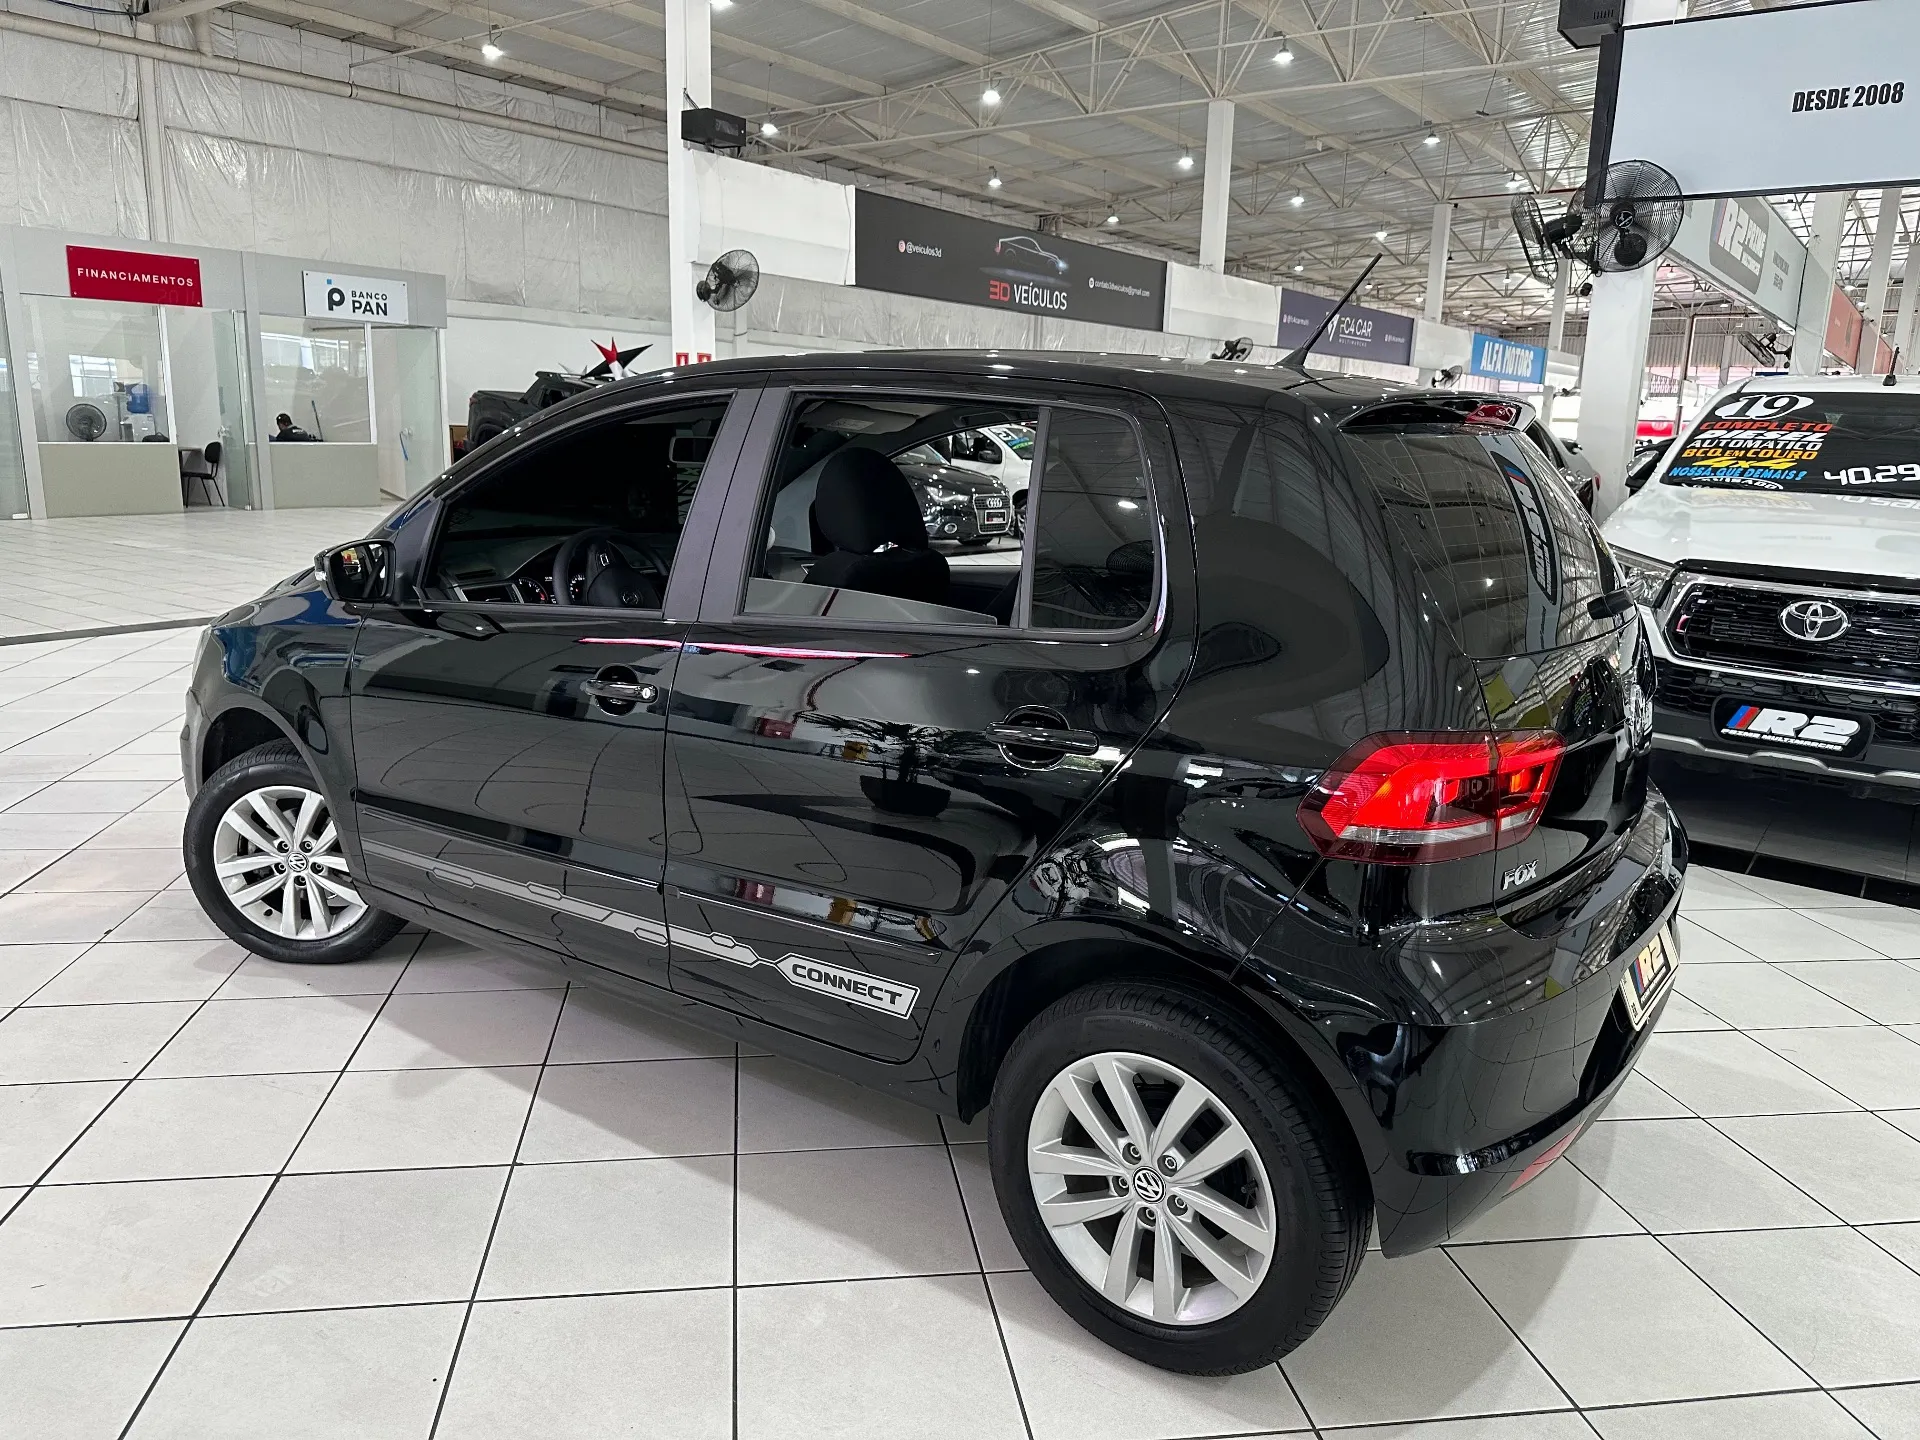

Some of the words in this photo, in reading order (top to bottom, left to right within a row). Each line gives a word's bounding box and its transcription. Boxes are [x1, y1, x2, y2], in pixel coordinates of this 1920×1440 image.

[1792, 87, 1851, 113] DESDE
[1852, 82, 1905, 108] 2008
[76, 267, 194, 287] FINANCIAMENTOS
[351, 290, 388, 301] BANCO
[989, 280, 1010, 302] 3D
[1013, 281, 1068, 310] VEÍCULOS
[351, 299, 388, 316] PAN
[1356, 318, 1373, 338] CAR
[1480, 340, 1503, 373] ALFA
[1502, 345, 1534, 378] MOTORS
[1722, 394, 1800, 419] 19
[1694, 429, 1828, 442] DIESEL
[1700, 421, 1833, 432] COMPLETO
[1724, 450, 1746, 458] EM
[1747, 448, 1818, 460] COURO
[1747, 707, 1861, 746] R2
[1502, 859, 1540, 891] FOX
[791, 962, 903, 1006] CONNECT
